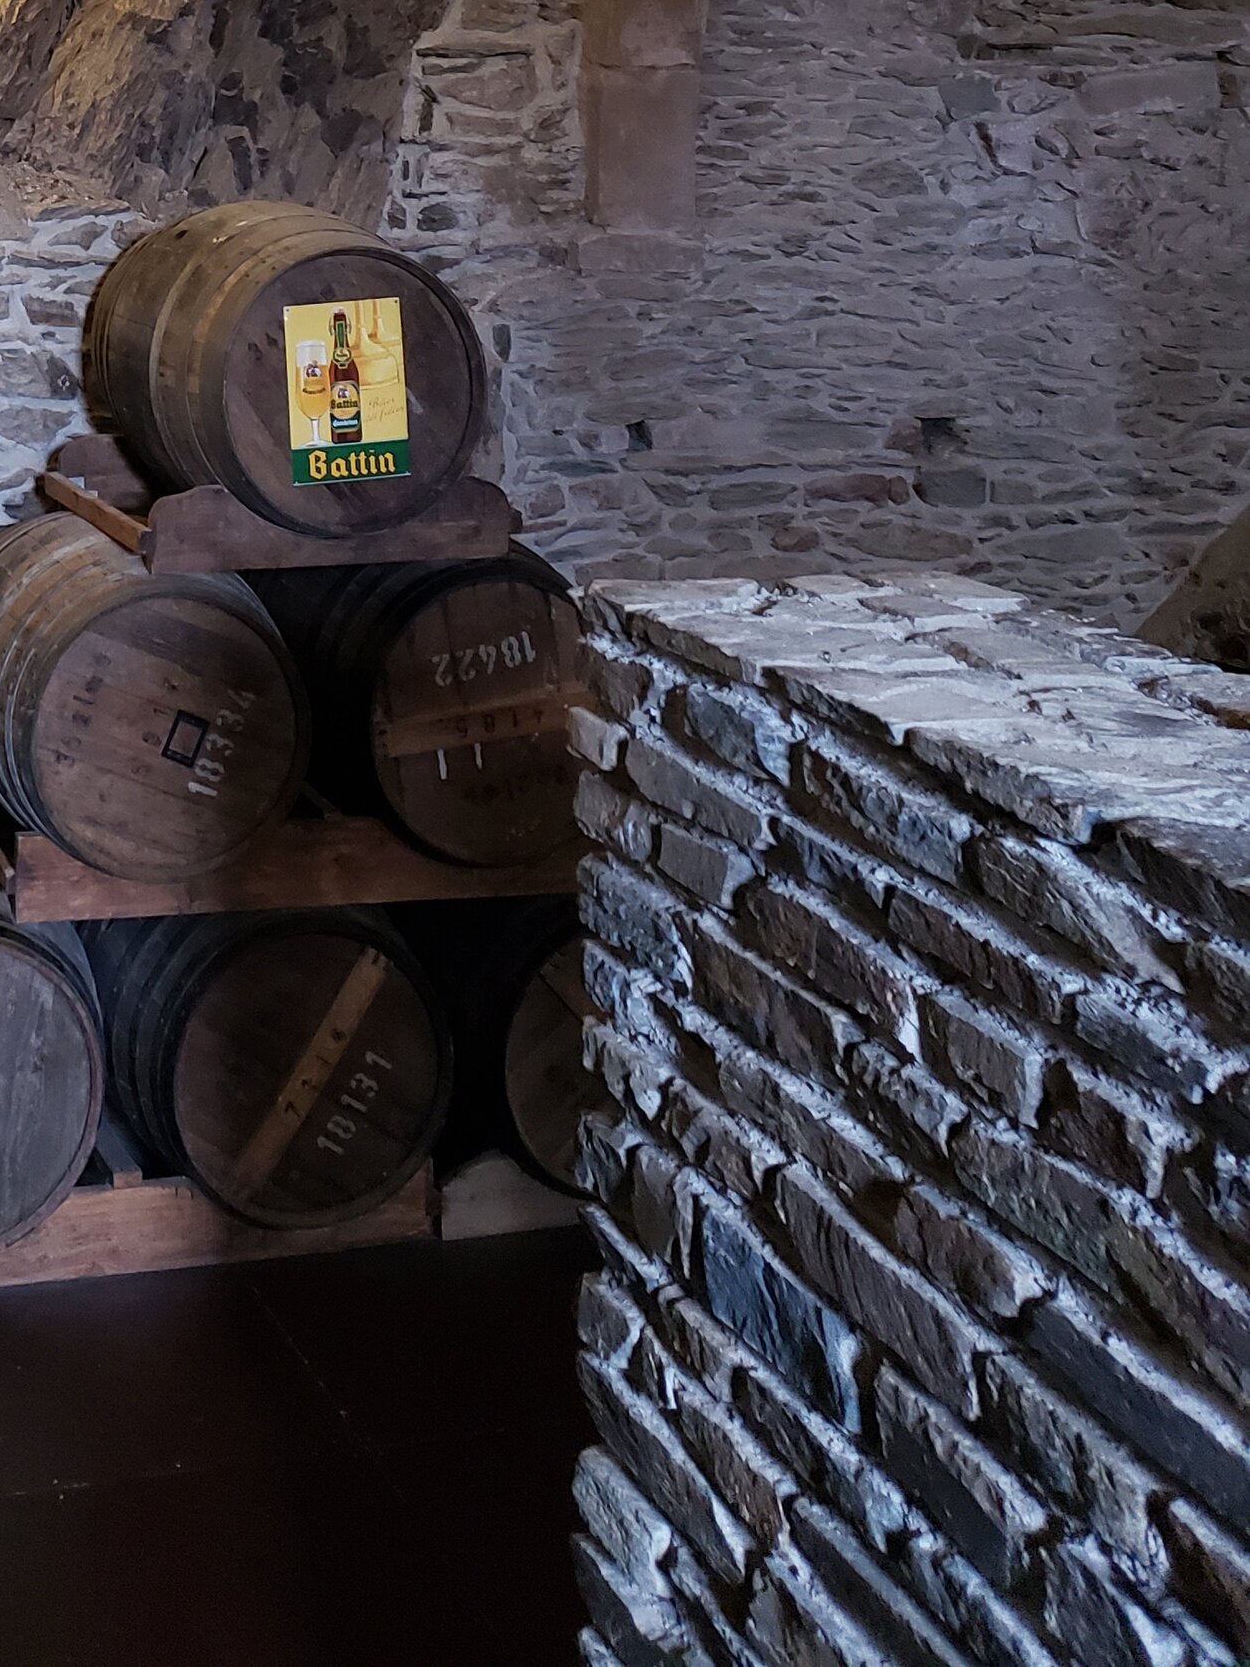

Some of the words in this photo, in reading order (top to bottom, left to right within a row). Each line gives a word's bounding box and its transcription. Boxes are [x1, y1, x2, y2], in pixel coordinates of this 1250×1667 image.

[308, 449, 396, 480] Battin
[431, 631, 536, 686] 18422
[187, 689, 256, 797] 18334
[317, 1050, 392, 1155] 18131
